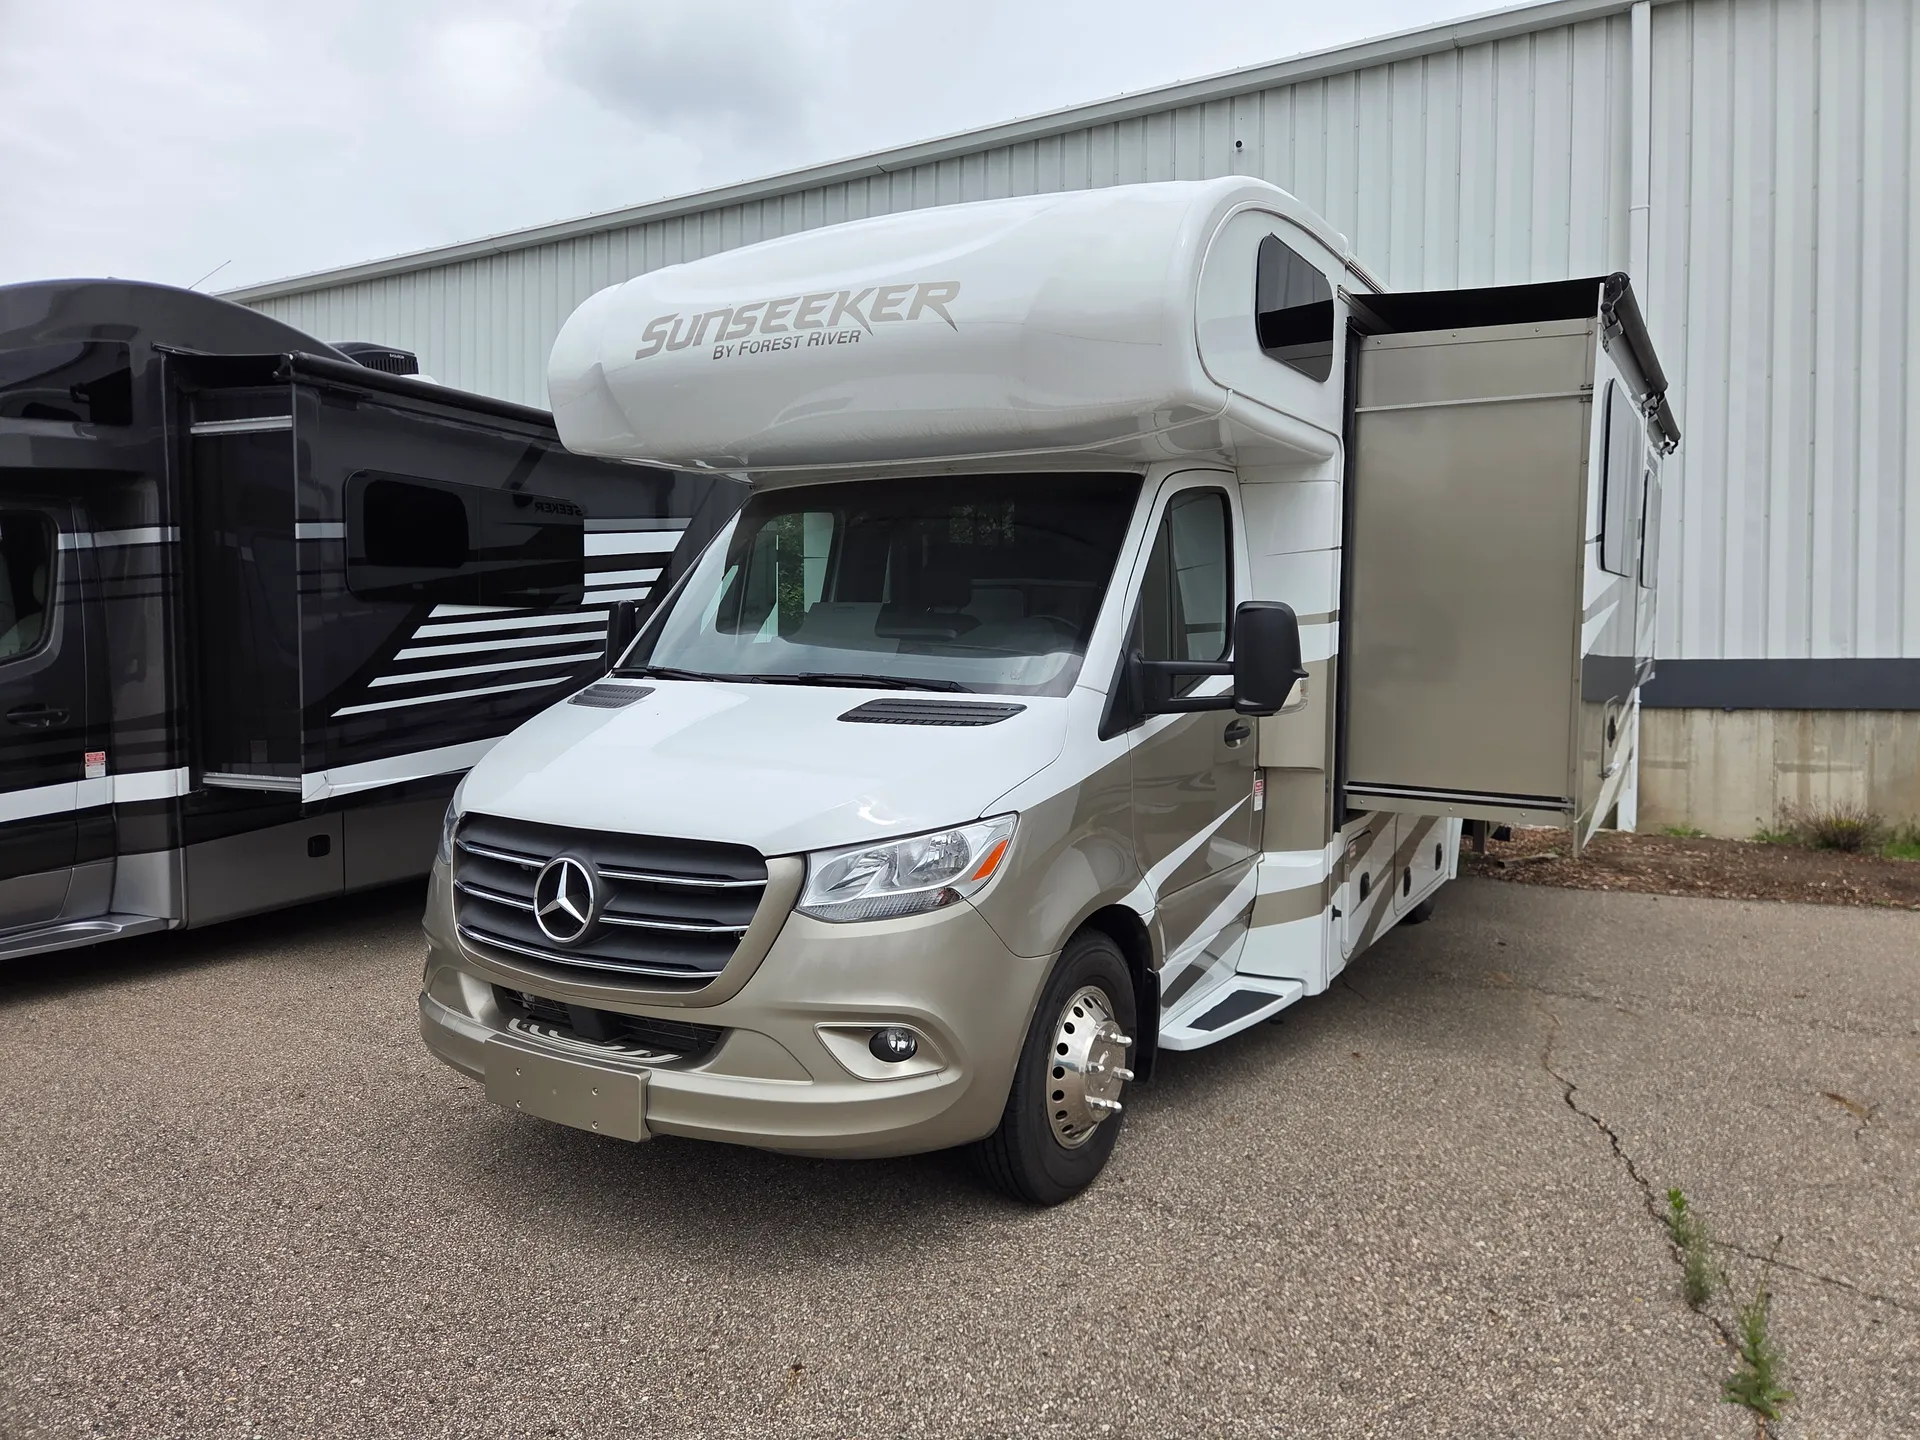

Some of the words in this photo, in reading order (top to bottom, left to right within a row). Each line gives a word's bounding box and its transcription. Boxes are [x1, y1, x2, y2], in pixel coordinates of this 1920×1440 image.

[635, 281, 960, 360] SUNSEEKER
[713, 344, 735, 360] BY
[738, 336, 804, 356] FOREST
[807, 330, 861, 347] RIVER
